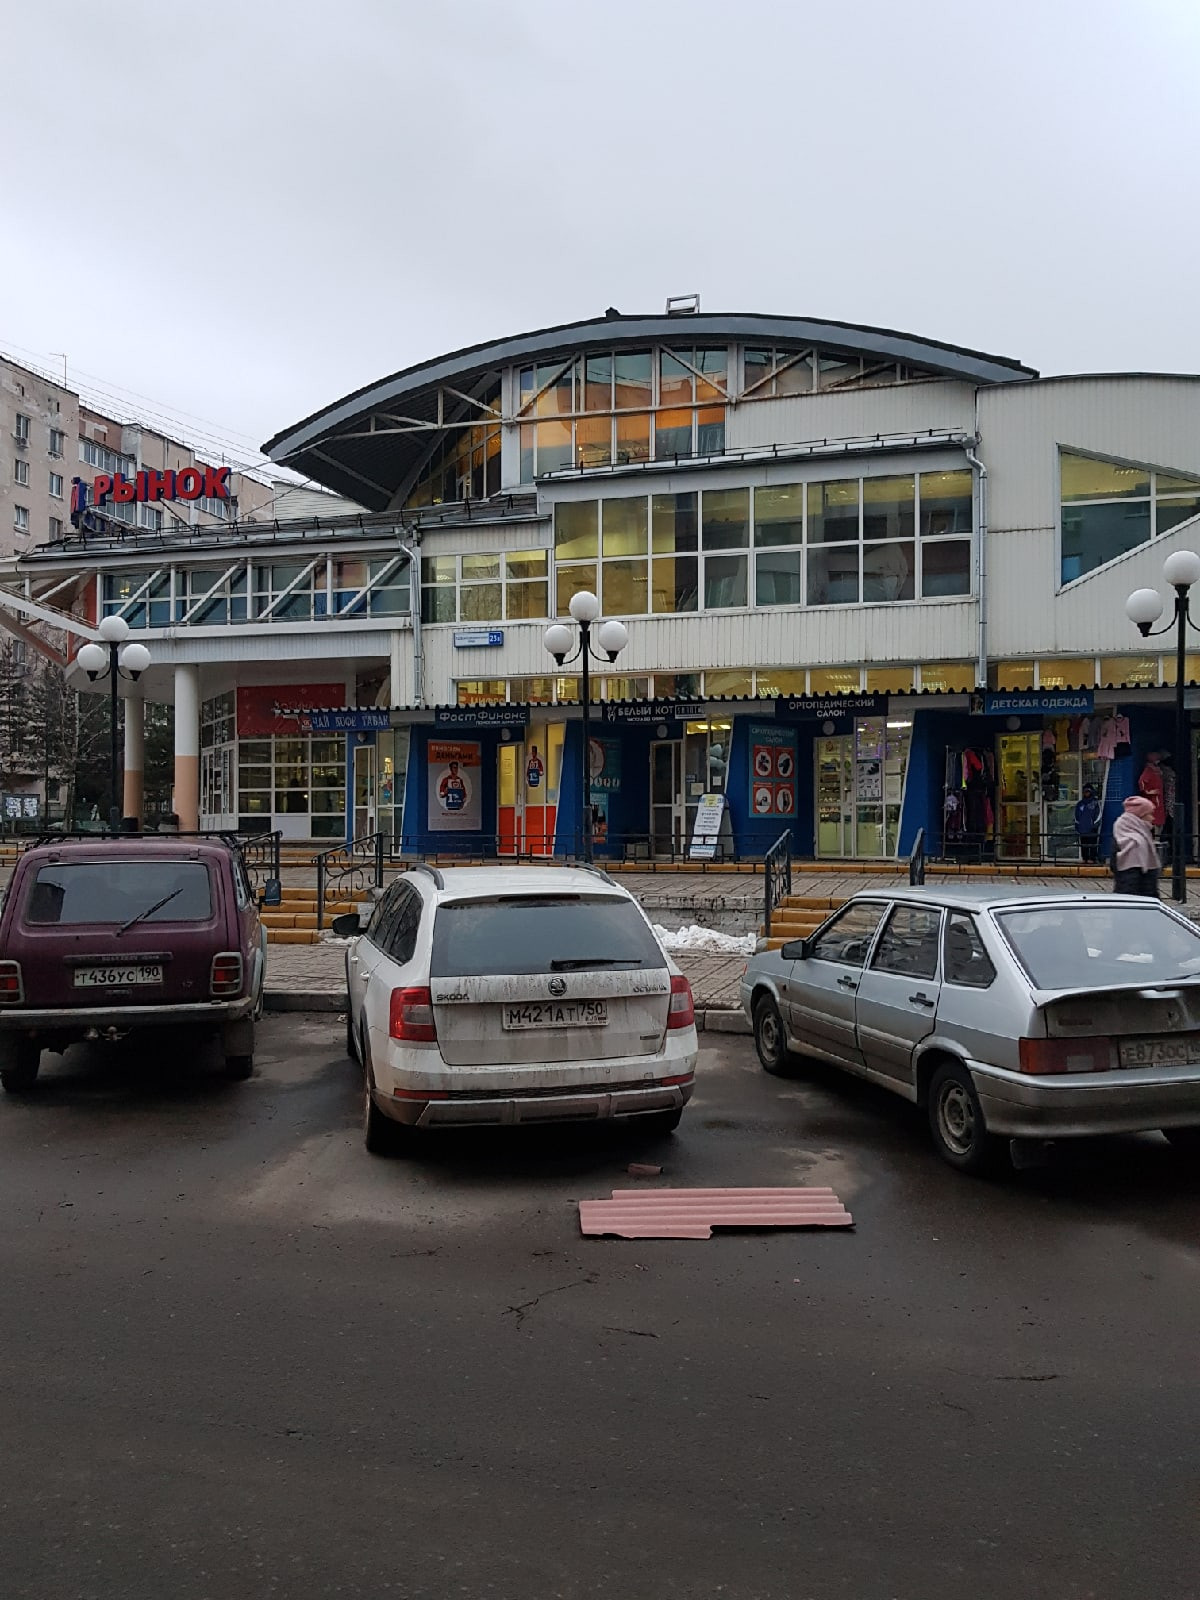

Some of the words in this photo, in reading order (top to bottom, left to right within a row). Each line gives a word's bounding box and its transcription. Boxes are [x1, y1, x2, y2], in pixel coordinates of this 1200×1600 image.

[94, 467, 231, 506] РЫНОК
[618, 704, 652, 716] БЕЛЫЙ
[655, 705, 674, 715] КОТ
[788, 698, 875, 710] ОРТОПЕДИЧЕСКИЙ
[990, 699, 1039, 710] ДЕТСКАЯ
[1041, 697, 1088, 709] ОДЕЖДА
[816, 710, 846, 718] САЛОН
[312, 714, 330, 728] ЧАЙ
[335, 715, 357, 727] КОФЕ
[361, 714, 389, 727] ТАБАК
[80, 969, 136, 984] Т436УС
[139, 966, 160, 978] 190
[509, 1005, 578, 1023] М421АТ
[579, 1002, 604, 1016] 750
